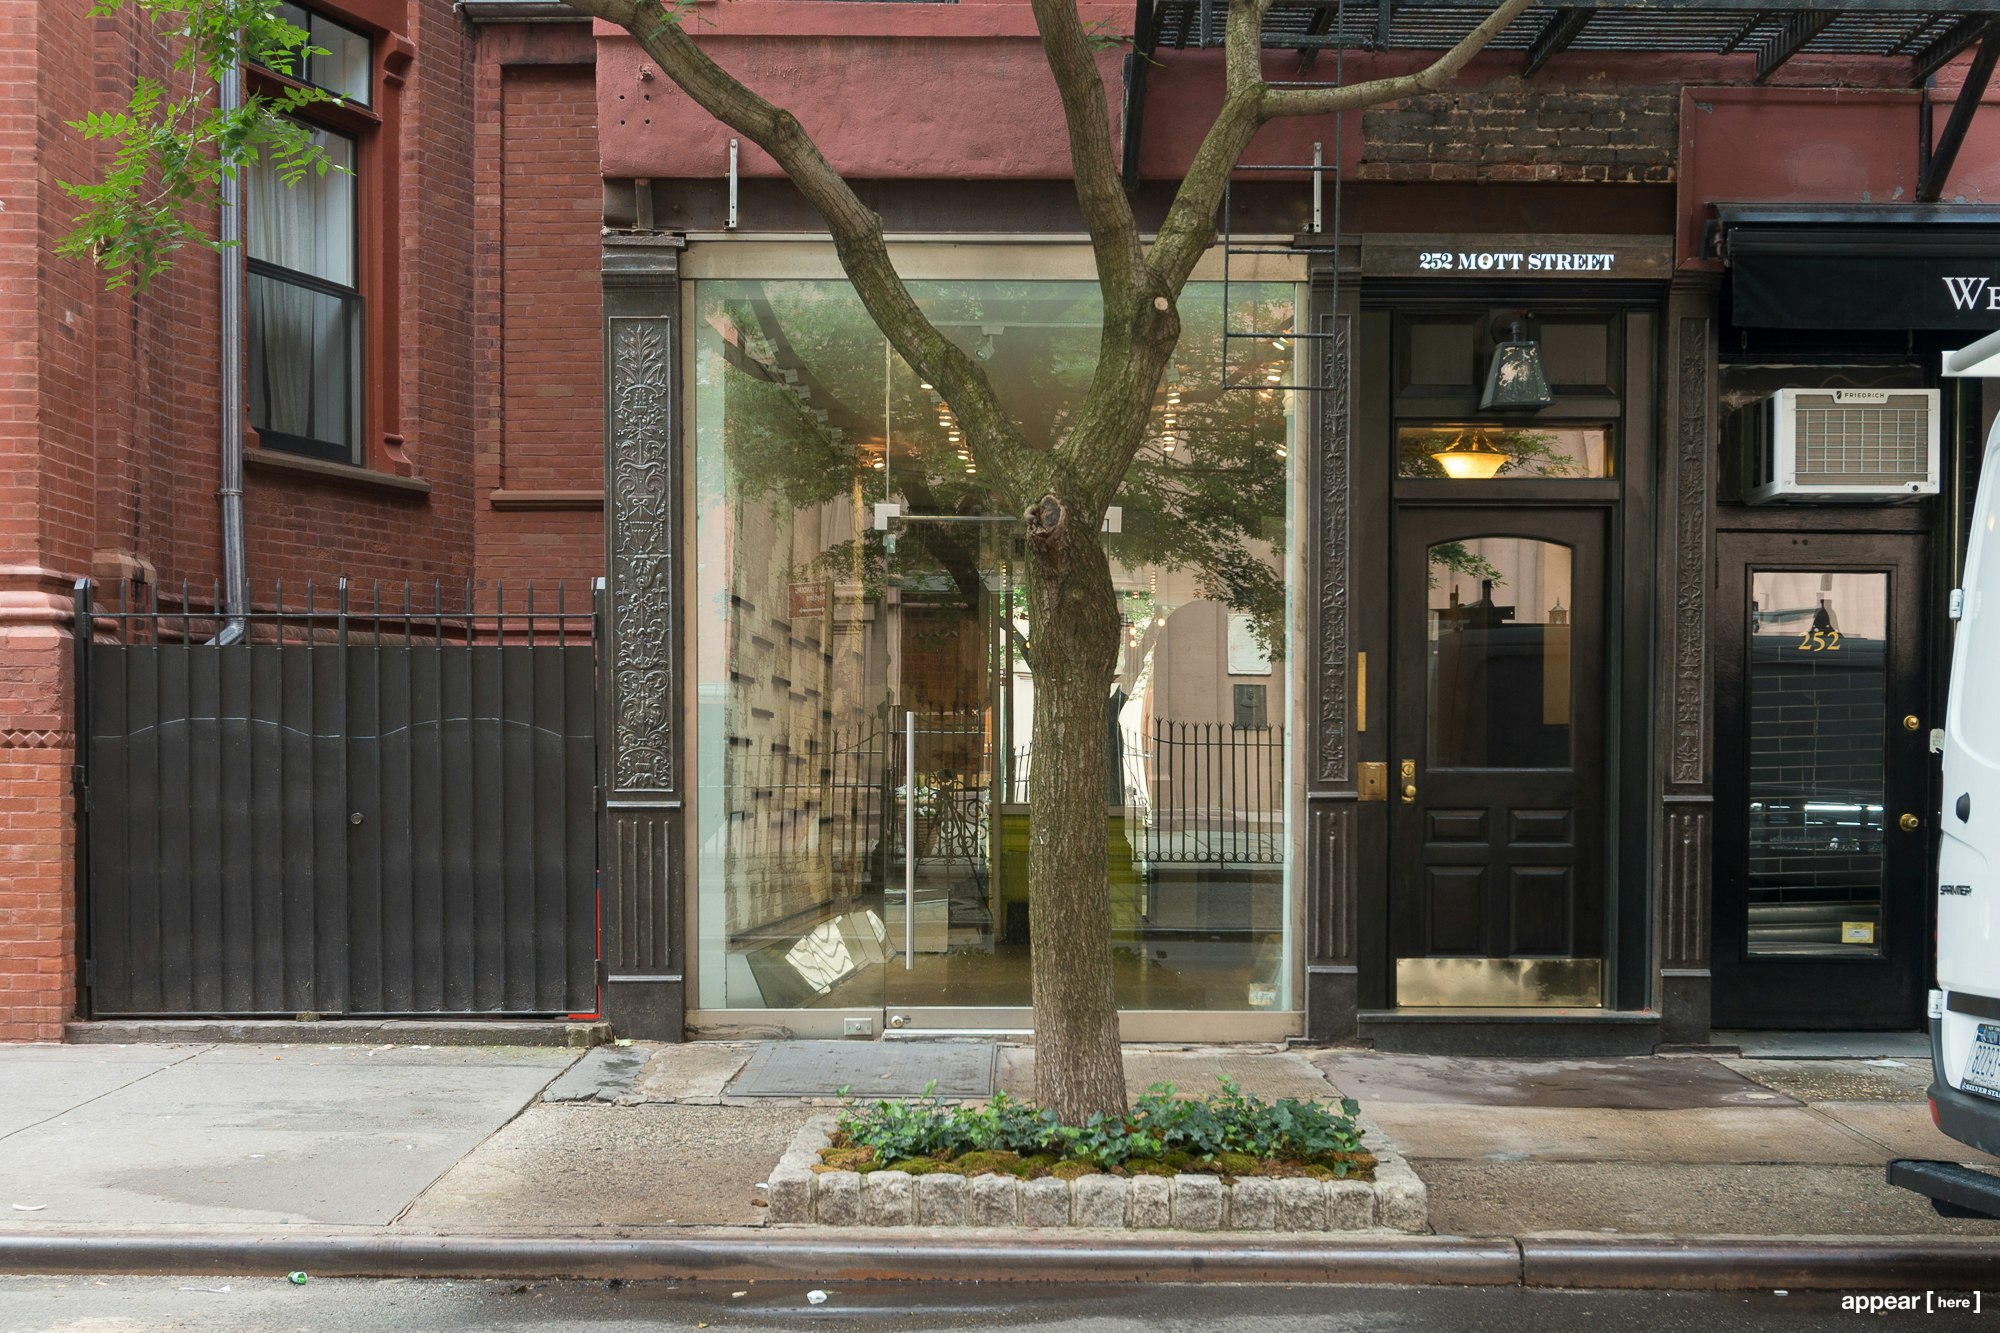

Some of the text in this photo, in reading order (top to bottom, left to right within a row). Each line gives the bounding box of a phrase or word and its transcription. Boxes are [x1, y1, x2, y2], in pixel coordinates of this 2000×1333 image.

[1419, 252, 1615, 271] 252 MOTT STREET
[1797, 631, 1841, 652] 252
[1966, 1083, 1988, 1095] SILVER
